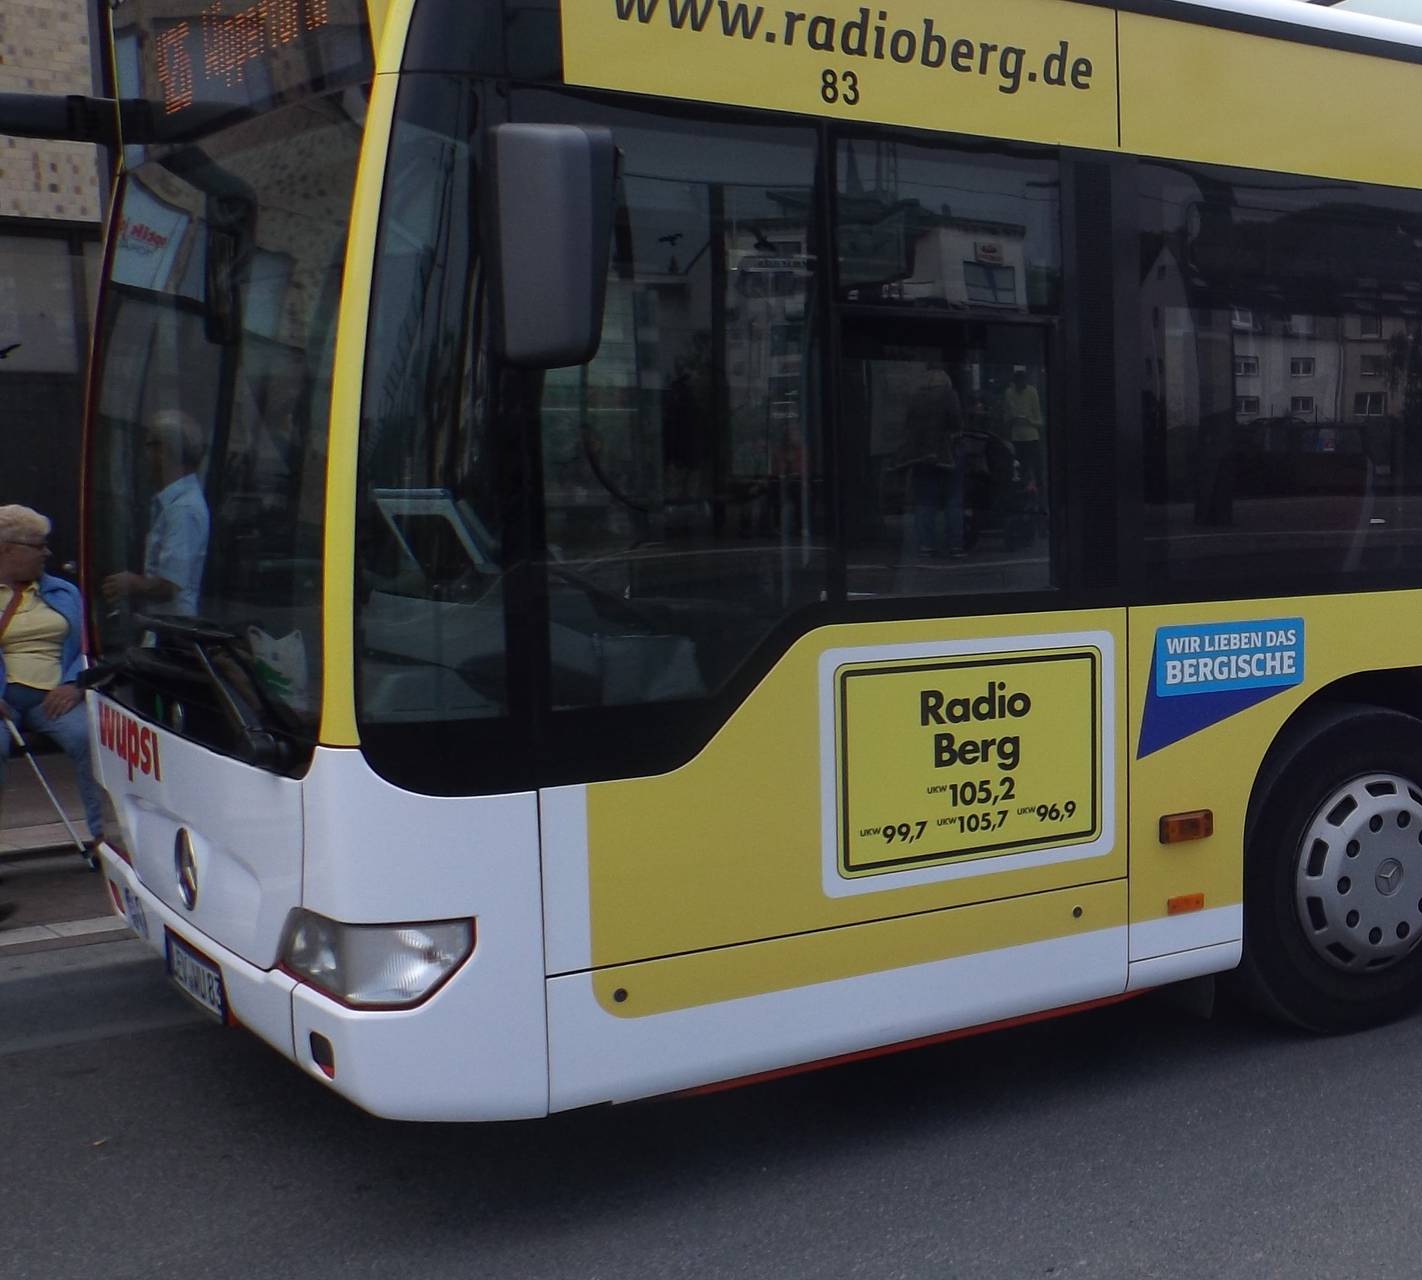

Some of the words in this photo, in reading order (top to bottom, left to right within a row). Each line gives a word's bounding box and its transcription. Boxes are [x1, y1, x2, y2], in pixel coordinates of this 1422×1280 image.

[615, 0, 1093, 94] www.radioberg.de
[821, 69, 860, 105] 83
[1166, 637, 1200, 655] WIR
[1204, 632, 1262, 652] LIEBEN
[1265, 629, 1296, 647] DAS
[1165, 651, 1296, 685] BERGISCHE
[920, 681, 1032, 726] Radio
[934, 733, 1020, 771] Berg
[927, 785, 948, 794] UKW
[949, 776, 1015, 807] 105,2
[860, 827, 881, 837] UKW
[882, 820, 928, 844] 99,7
[937, 817, 957, 826] UKW
[957, 810, 1008, 833] 105,7
[1017, 806, 1036, 816] UKW
[1036, 800, 1077, 822] 96,9
